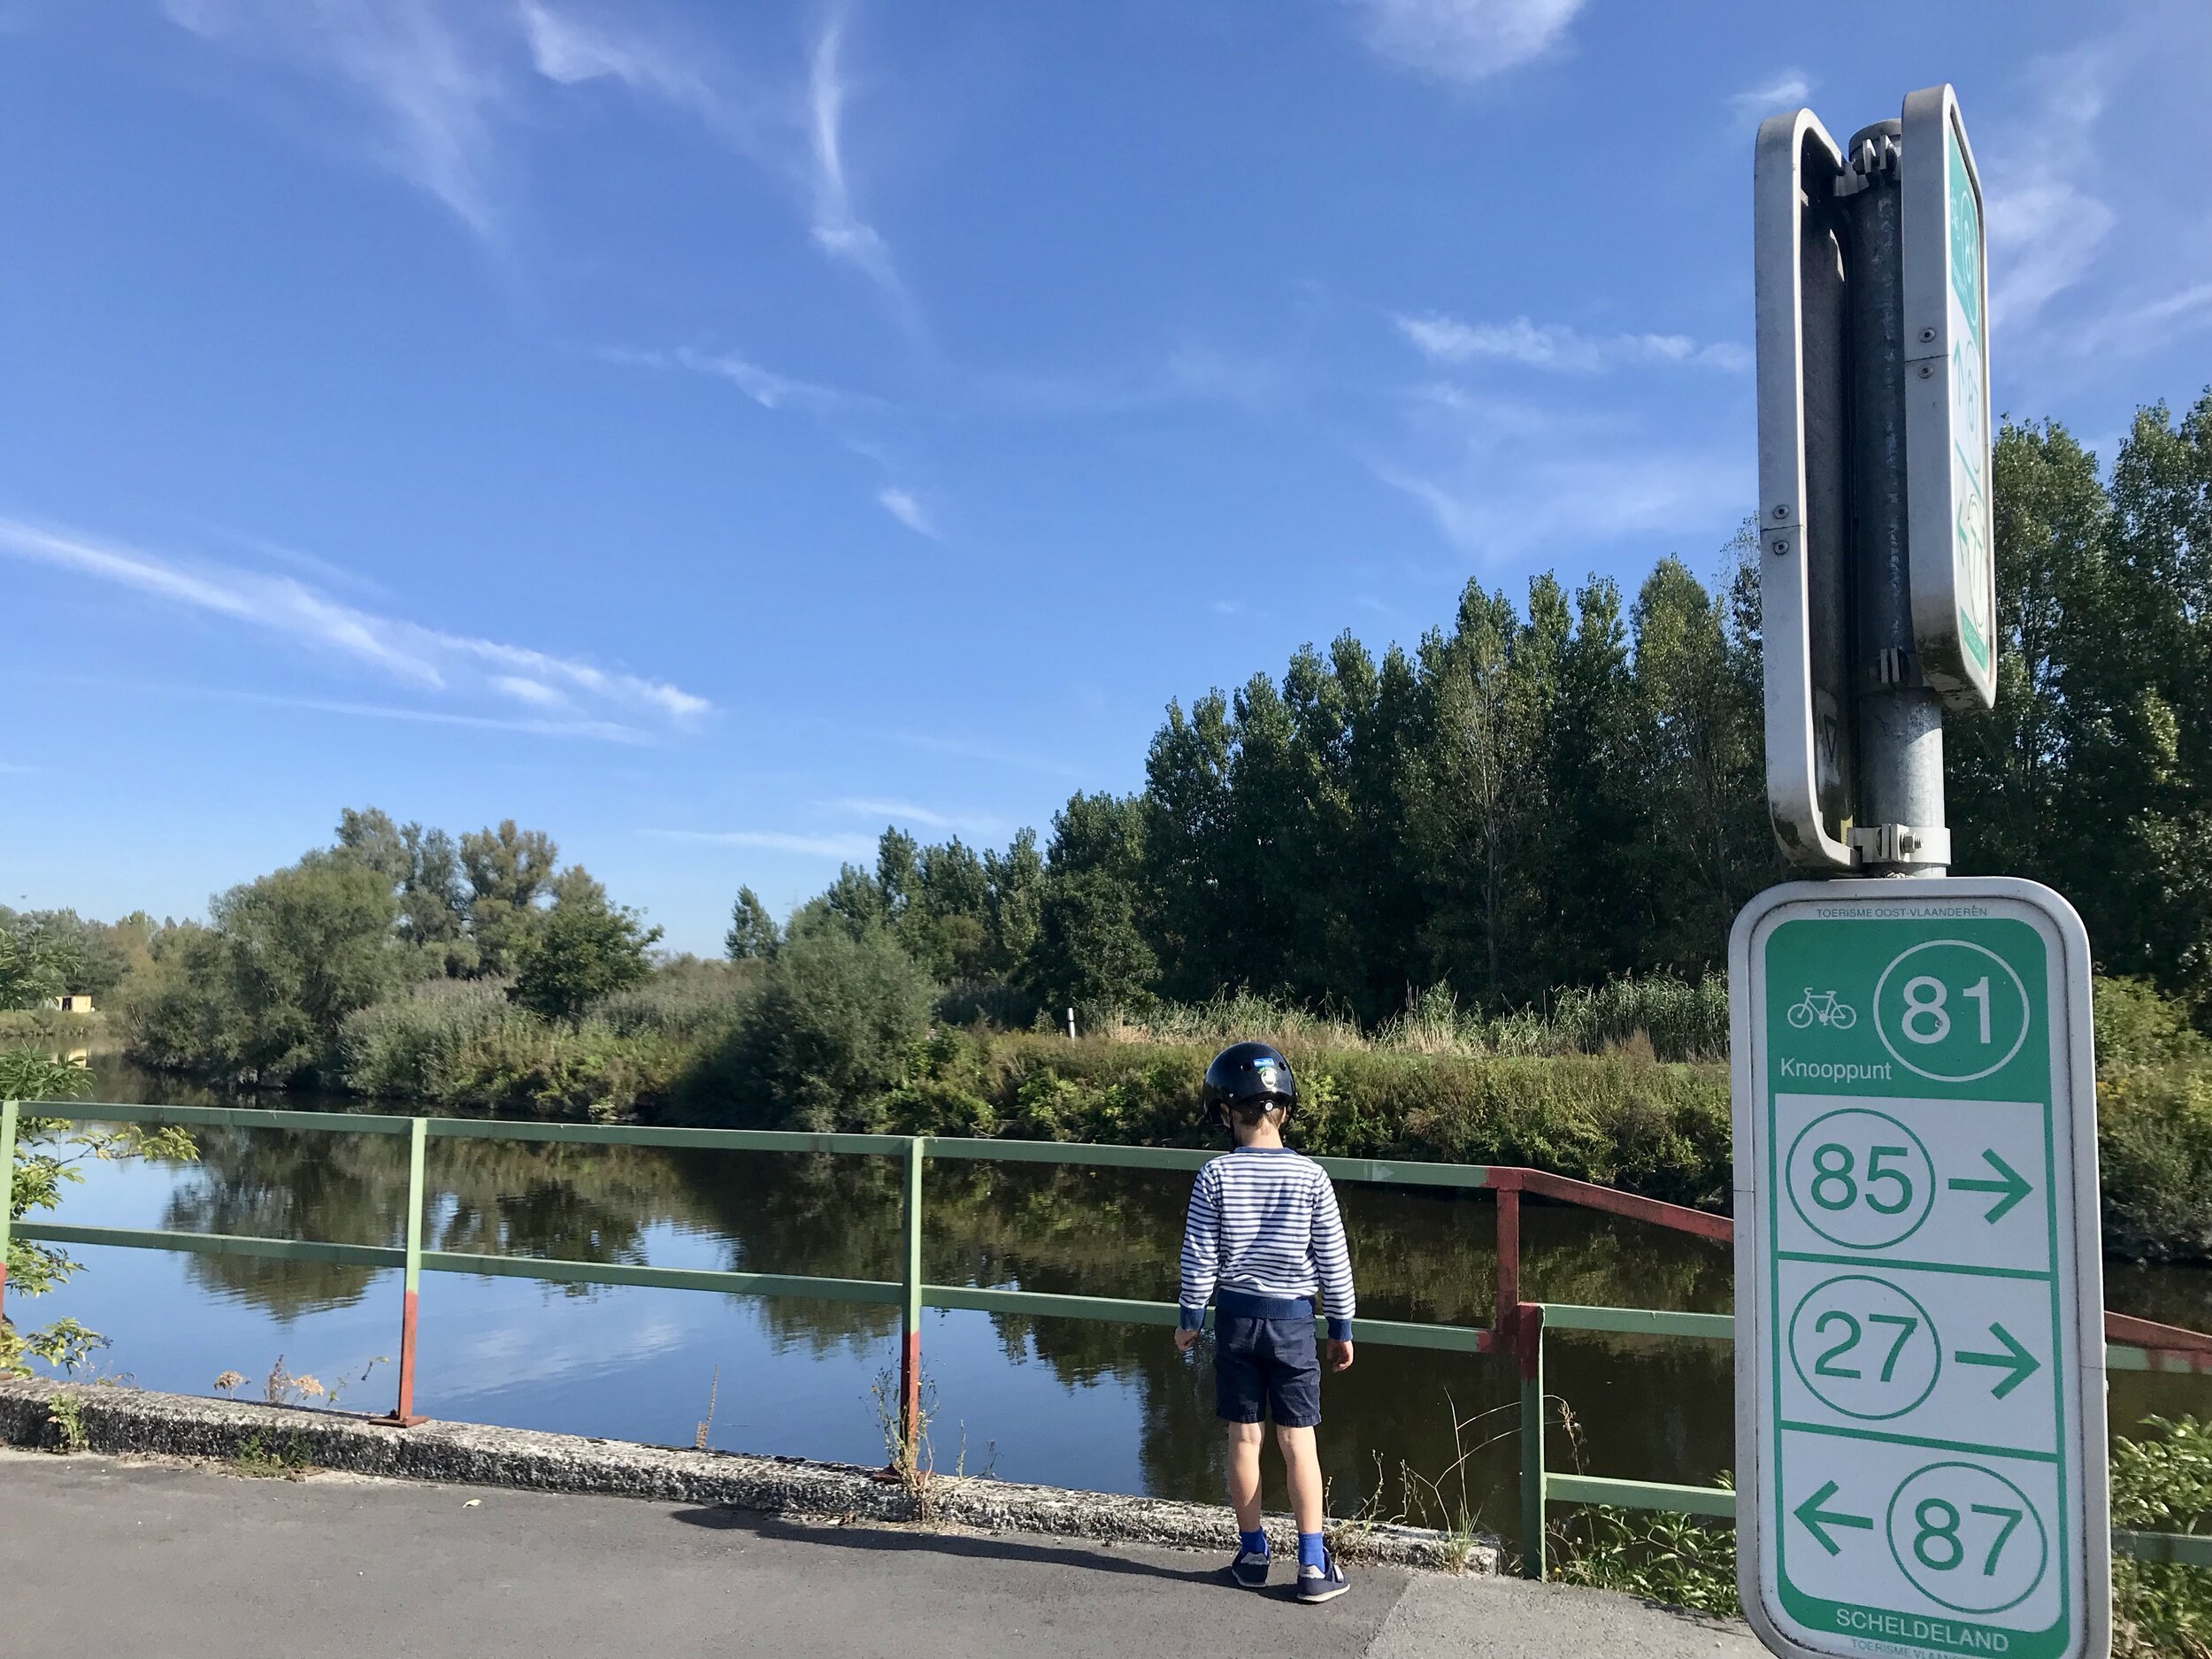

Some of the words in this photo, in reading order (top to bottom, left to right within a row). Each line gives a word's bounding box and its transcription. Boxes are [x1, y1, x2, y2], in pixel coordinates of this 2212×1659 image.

[1964, 219, 1976, 298] 81
[1968, 368, 1978, 442] 87
[1816, 908, 1872, 918] TOERISME
[1875, 907, 1987, 918] OOST-VLAANDEREN
[1901, 975, 1991, 1044] 81
[1780, 1057, 1892, 1083] Knooppunt
[1810, 1142, 1913, 1215] 85
[1815, 1310, 1918, 1383] 27
[1913, 1498, 2023, 1576] 87
[1836, 1609, 2009, 1652] SCHELDELAND
[1852, 1639, 1911, 1657] TOERISME
